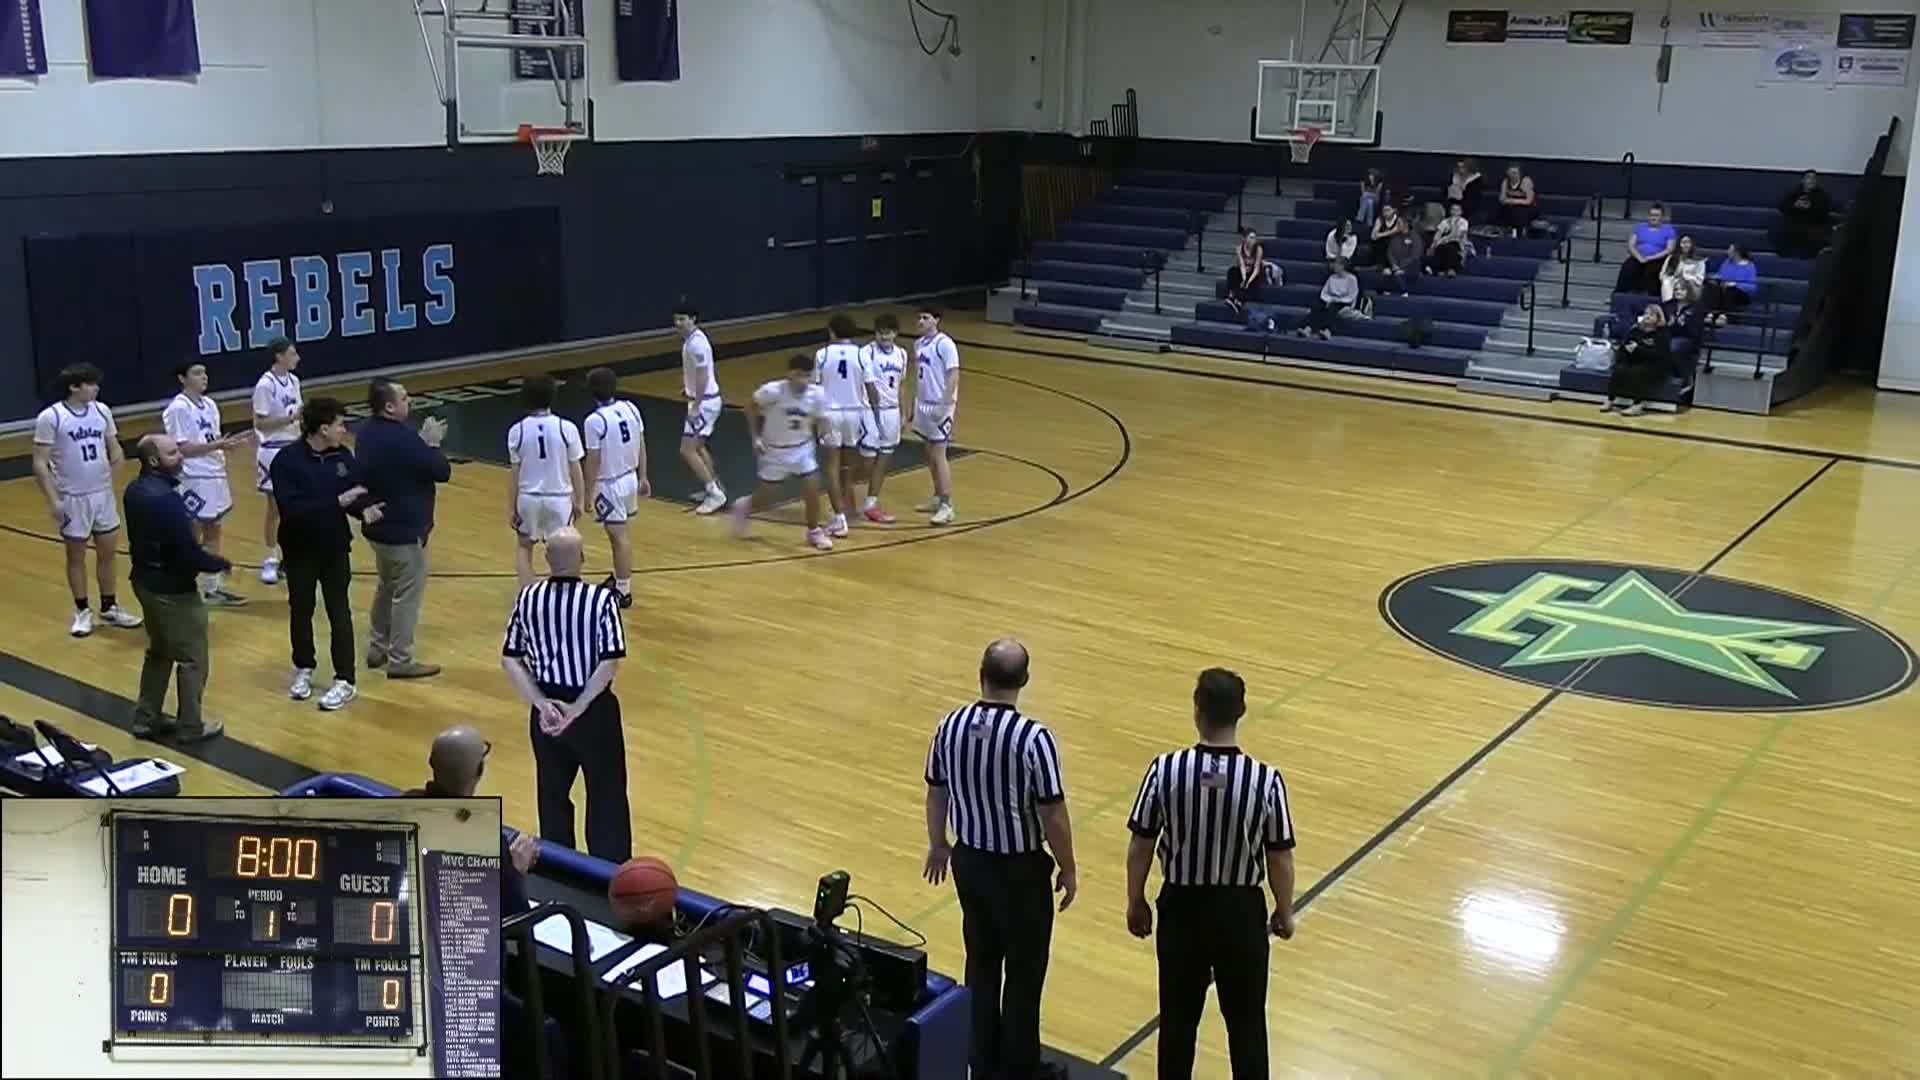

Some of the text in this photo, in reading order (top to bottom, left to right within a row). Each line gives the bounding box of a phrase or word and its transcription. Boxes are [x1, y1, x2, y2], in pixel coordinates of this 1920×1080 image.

[193, 244, 456, 355] REBELS
[837, 359, 847, 379] 4
[80, 443, 98, 463] 13
[537, 435, 547, 460] 1
[237, 835, 318, 880] 8:00
[441, 854, 464, 867] MVC
[137, 865, 188, 886] HOME
[340, 873, 391, 894] GUEST
[247, 888, 283, 902] PERIOD
[168, 893, 192, 936] 0
[268, 909, 274, 938] 1
[371, 901, 394, 942] 0
[120, 951, 178, 966] TM FOULS
[224, 953, 315, 970] PLAYER FOULS
[355, 958, 408, 972] TM FOULS
[149, 972, 169, 1004] 0
[383, 979, 400, 1010] 0
[130, 1009, 168, 1023] POINTS
[251, 1012, 284, 1025] MATCH
[365, 1015, 400, 1028] POINTS
